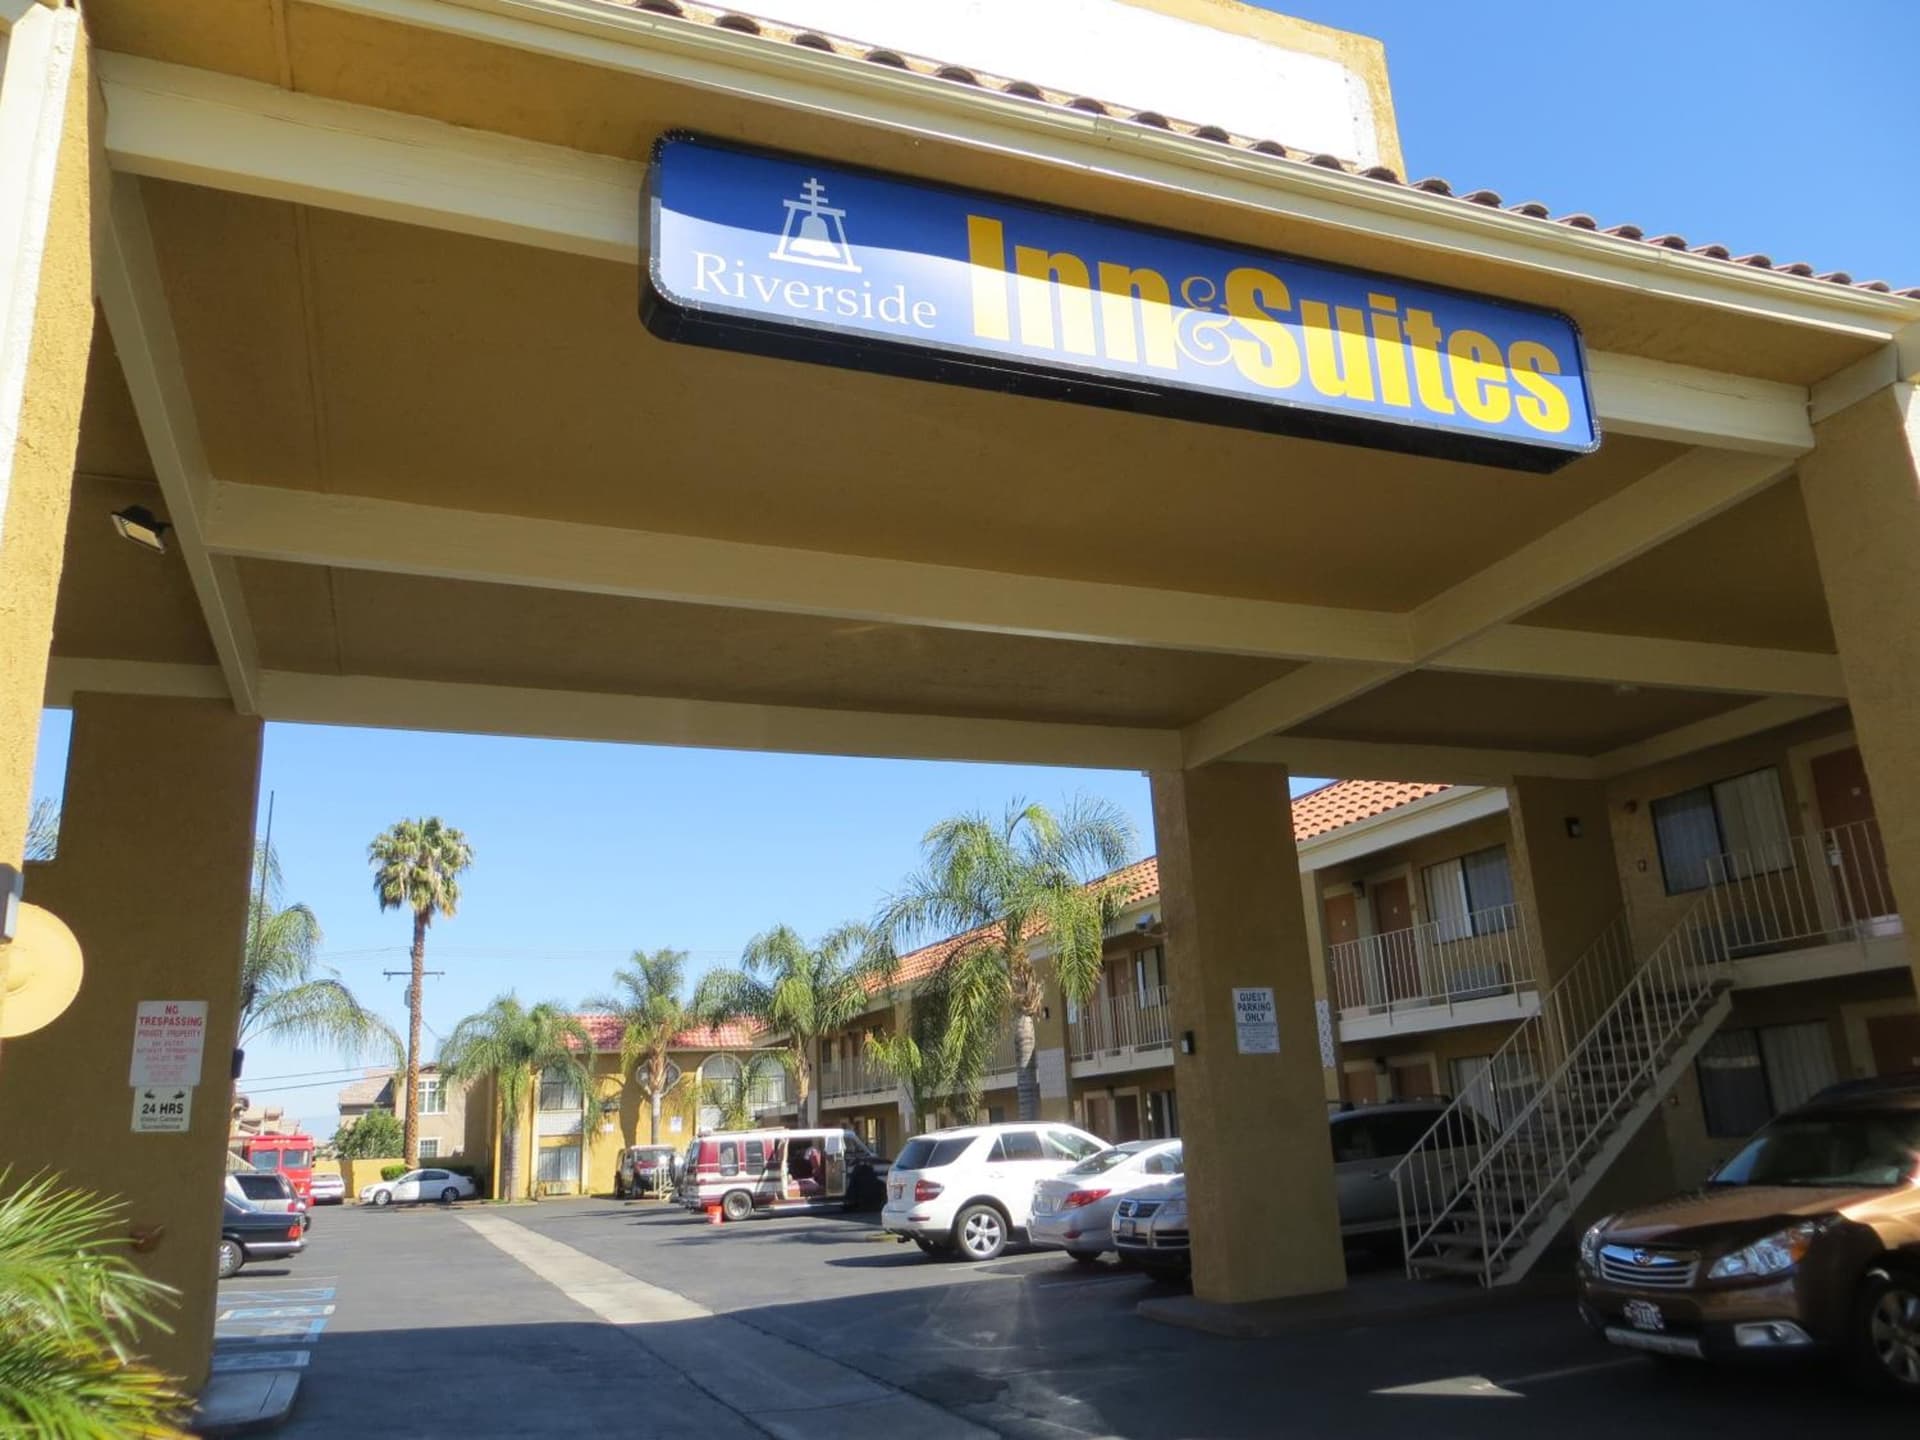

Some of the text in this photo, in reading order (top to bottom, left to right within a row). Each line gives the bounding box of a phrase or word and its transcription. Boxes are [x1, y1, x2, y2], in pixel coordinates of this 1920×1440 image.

[692, 250, 938, 329] Riverside
[966, 214, 1178, 371] Inn
[1223, 266, 1571, 434] Suites
[1240, 992, 1267, 1002] GUEST
[165, 1004, 179, 1015] NO
[1237, 1002, 1272, 1012] PARKING
[138, 1015, 203, 1027] TRESPASSING
[1245, 1013, 1266, 1022] ONLY
[142, 1103, 184, 1115] 24 HRS
